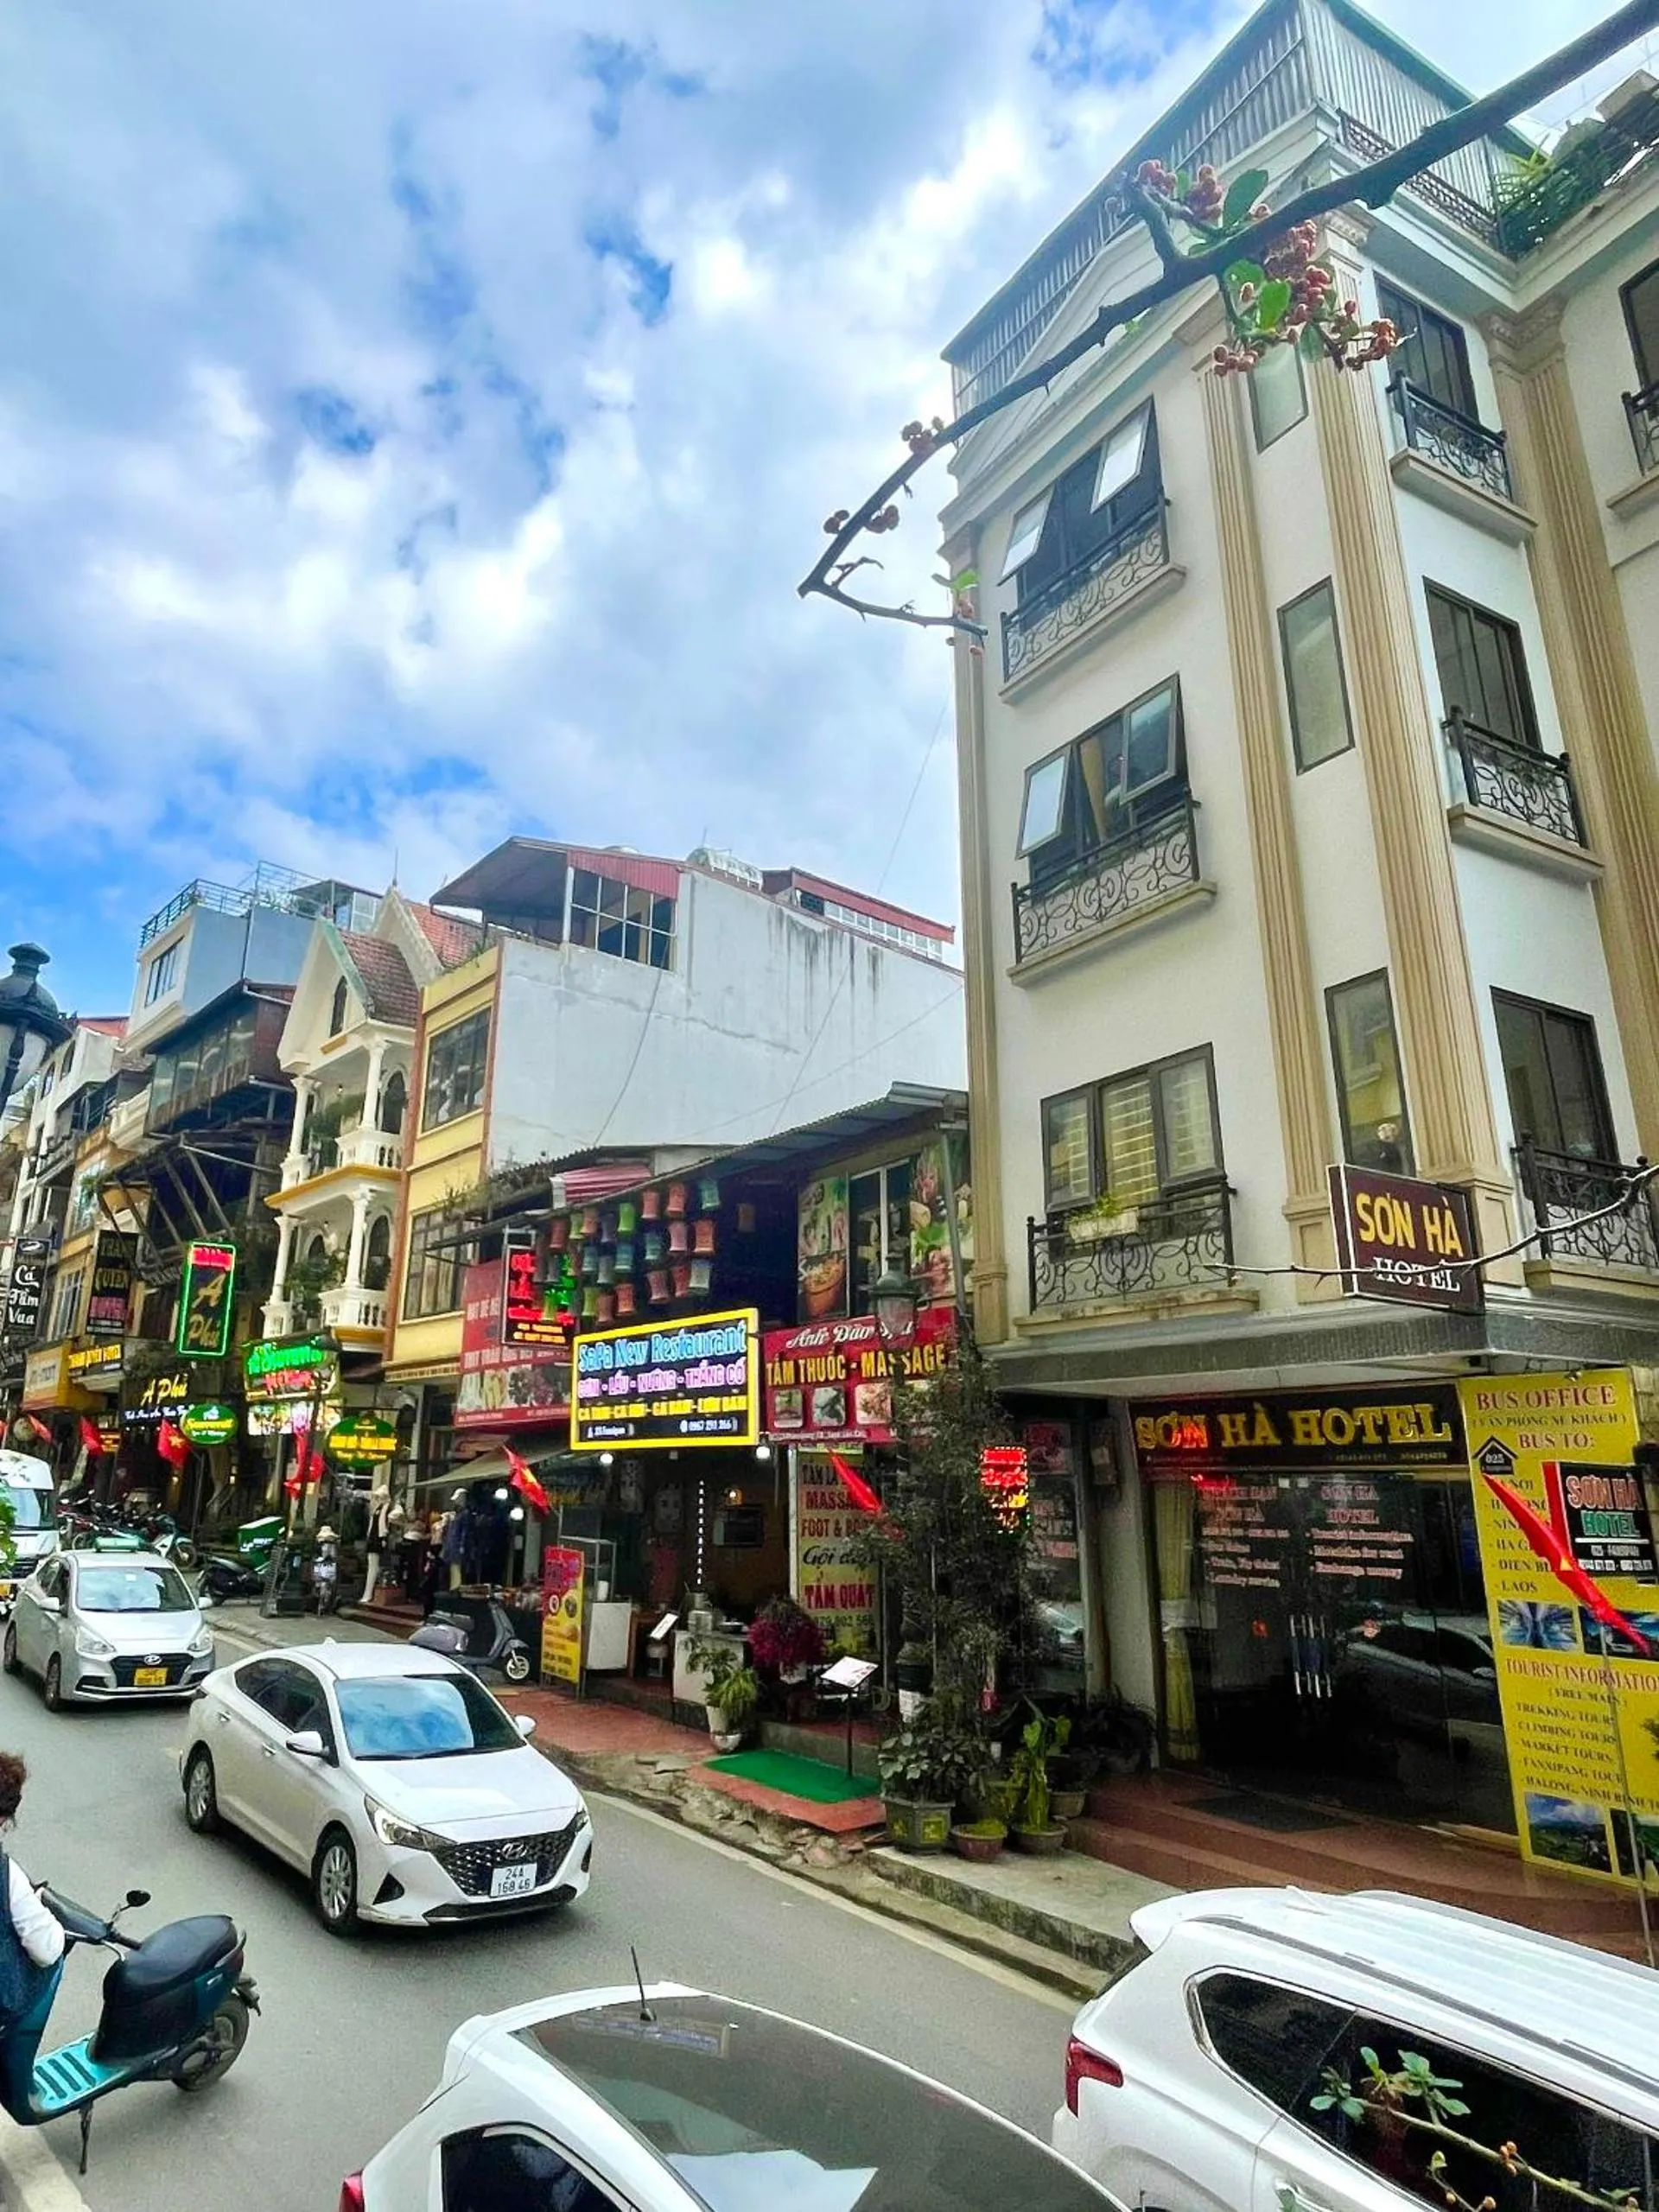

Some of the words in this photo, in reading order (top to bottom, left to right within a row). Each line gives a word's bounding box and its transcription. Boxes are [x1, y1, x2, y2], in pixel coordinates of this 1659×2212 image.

[1355, 1192, 1416, 1249] SƠN
[1422, 1196, 1464, 1257] HÀ
[1373, 1256, 1460, 1292] HOTEL
[192, 1273, 226, 1308] A
[614, 1338, 650, 1368] New
[651, 1319, 747, 1363] Restaurant
[1476, 1390, 1519, 1410] BUS
[1525, 1385, 1617, 1408] OFFICE
[1135, 1412, 1209, 1449] SƠN
[1217, 1402, 1282, 1447] HÀ
[1288, 1403, 1453, 1446] HOTEL
[1519, 1433, 1555, 1448] BUS
[1563, 1433, 1594, 1447] TO:
[1581, 1510, 1640, 1537] HOTEL
[1502, 1581, 1538, 1592] LAOS
[1506, 1658, 1560, 1679] TOURIST
